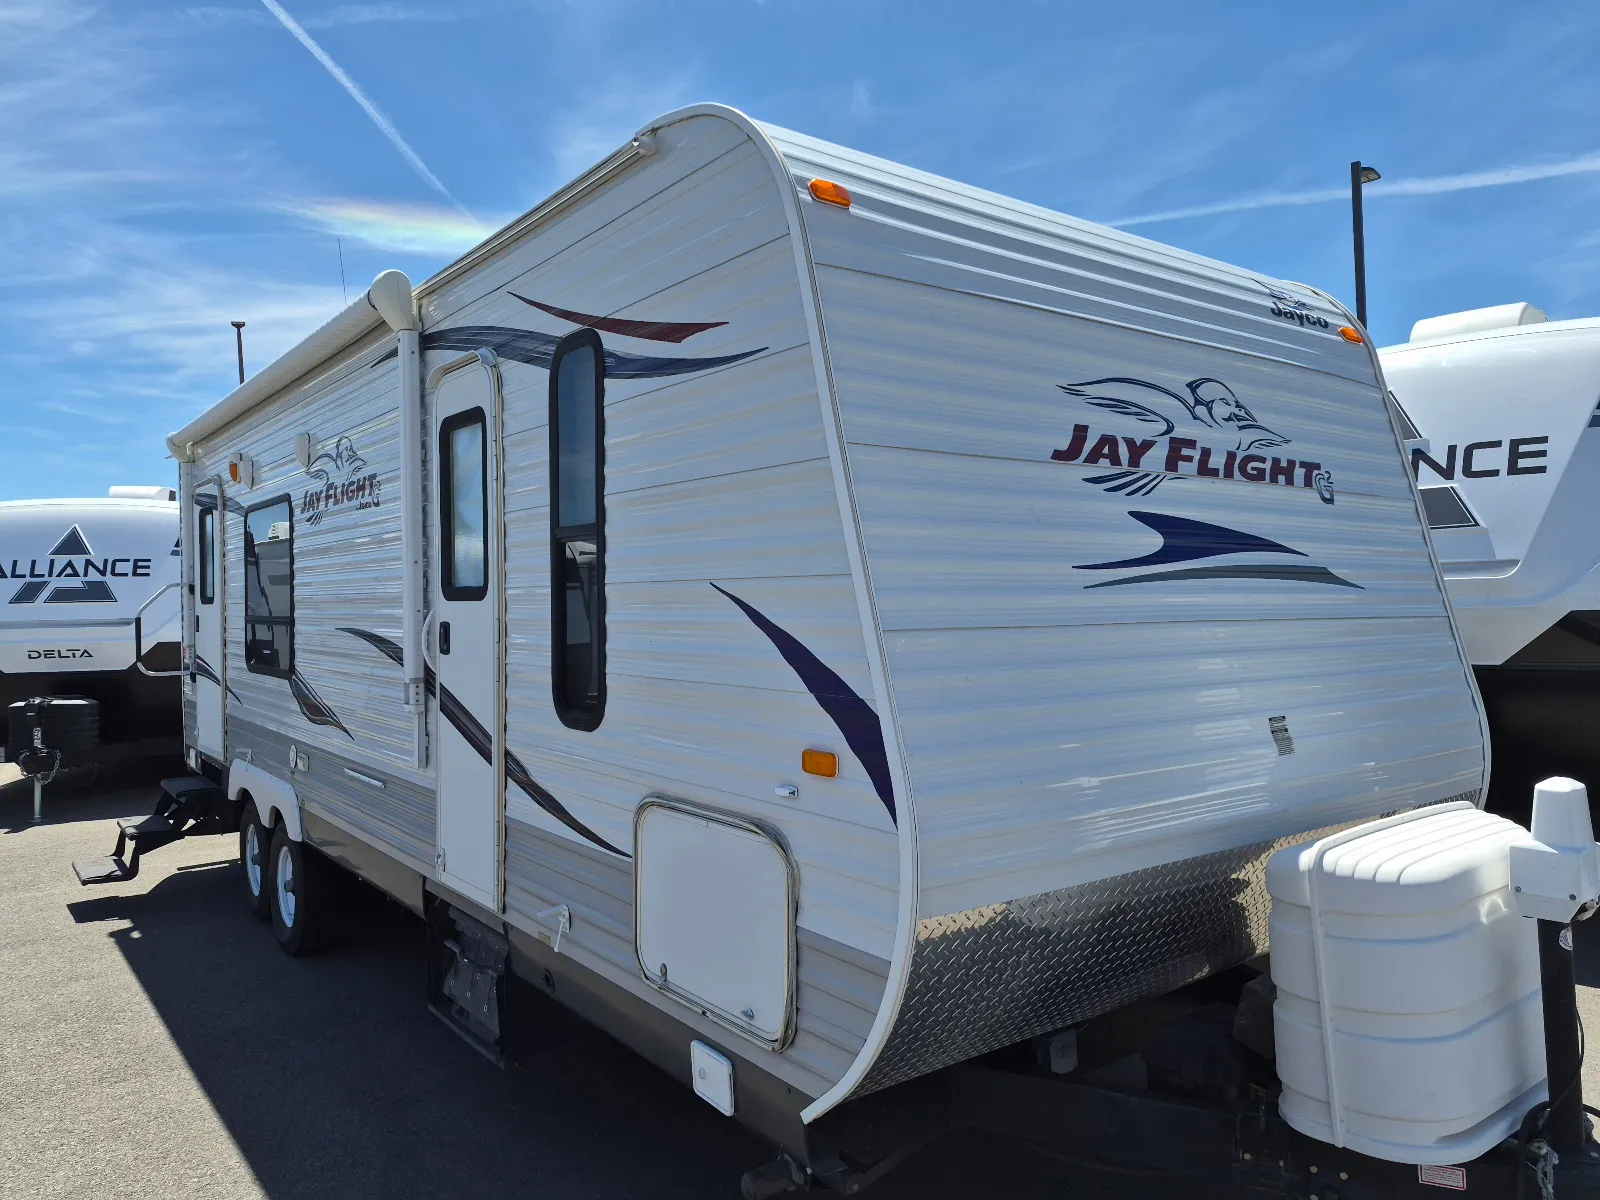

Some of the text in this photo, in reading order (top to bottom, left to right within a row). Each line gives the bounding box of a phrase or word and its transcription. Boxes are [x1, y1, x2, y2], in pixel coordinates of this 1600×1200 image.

[1270, 301, 1329, 329] Jayco
[1050, 423, 1158, 469] JAY
[1164, 436, 1322, 488] FLIGHT
[300, 489, 323, 515] JAY
[324, 472, 378, 509] FLIGHT
[27, 649, 94, 660] DELTA
